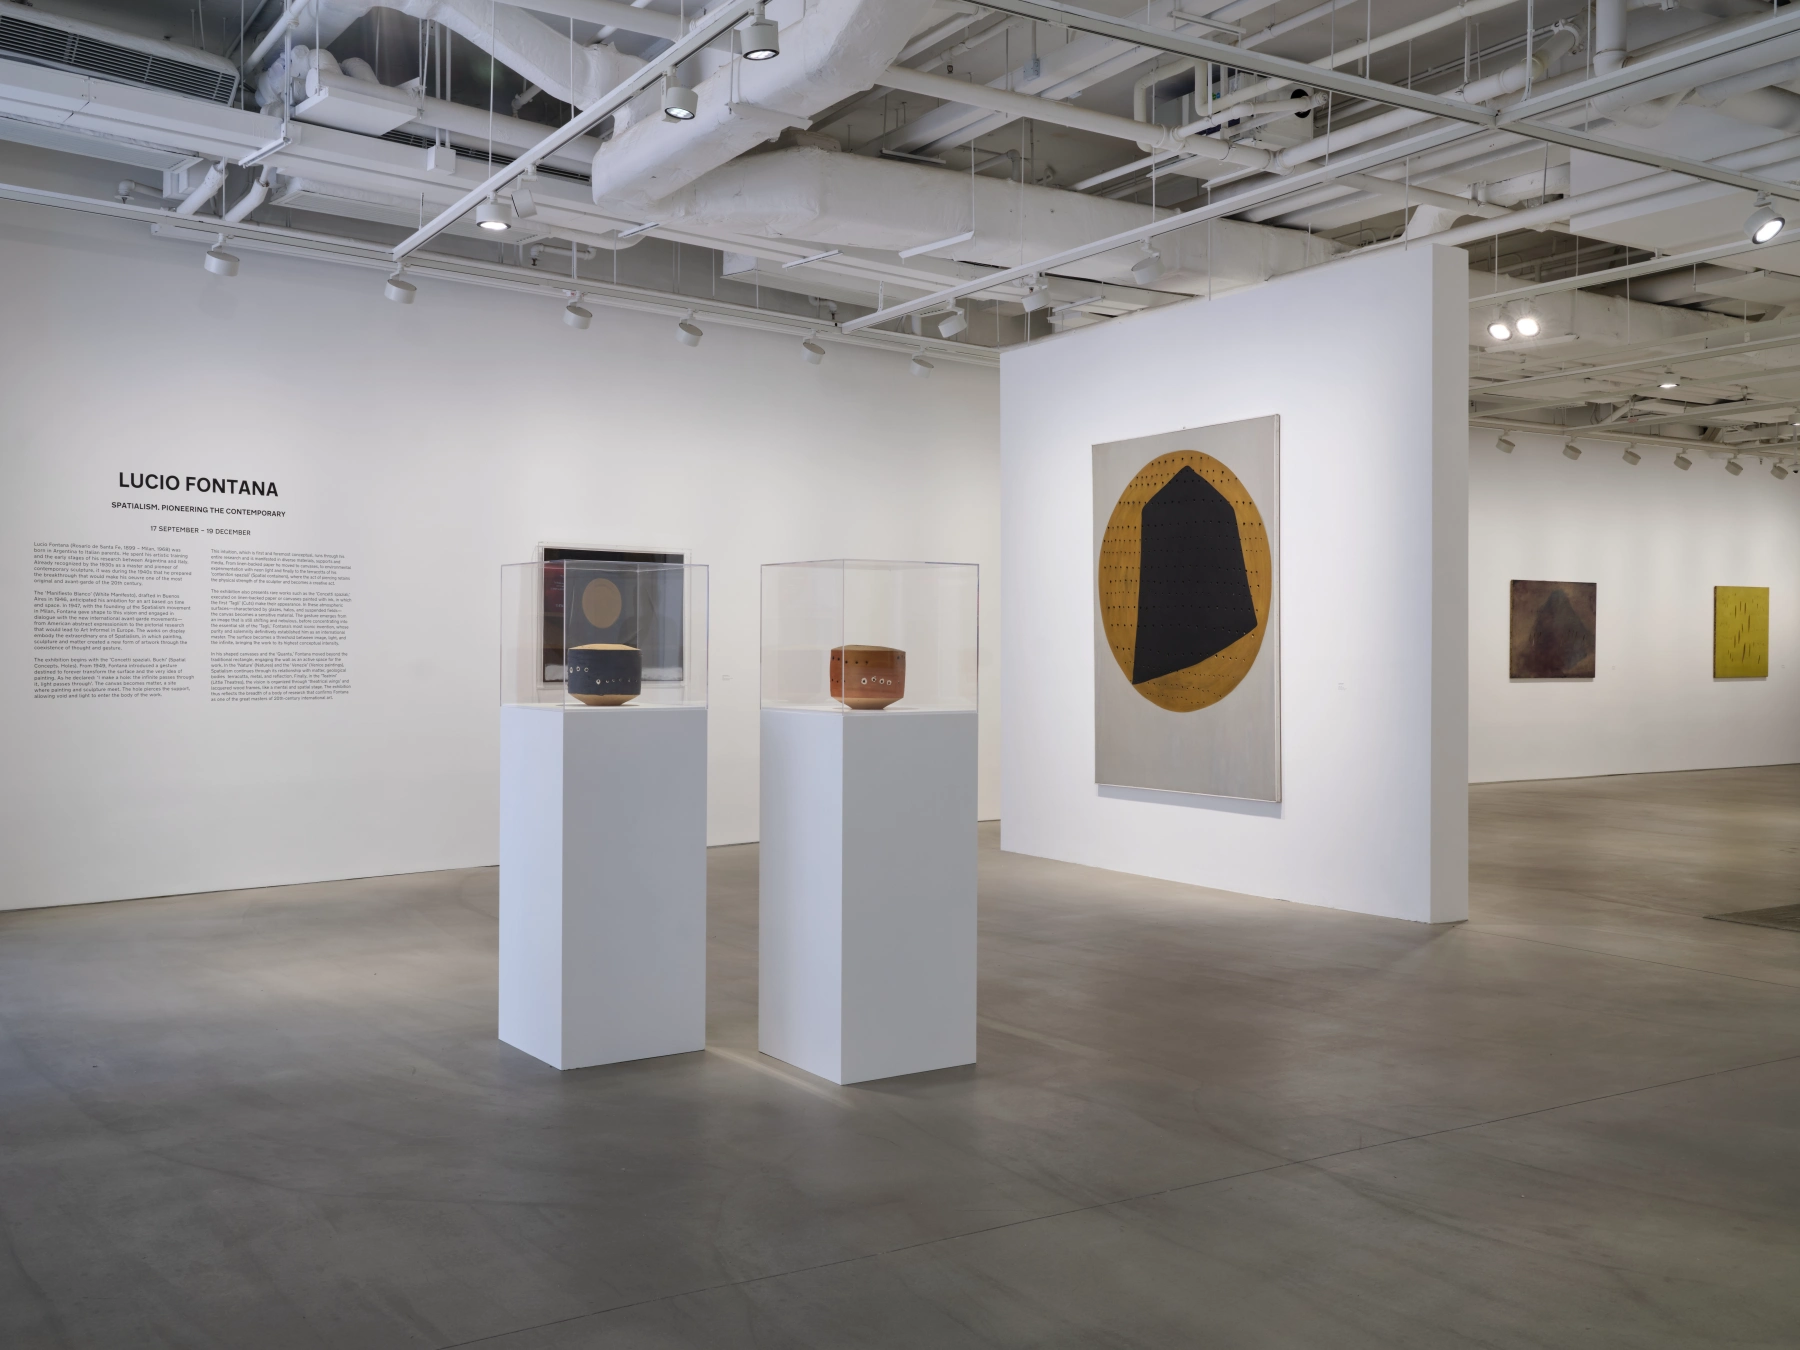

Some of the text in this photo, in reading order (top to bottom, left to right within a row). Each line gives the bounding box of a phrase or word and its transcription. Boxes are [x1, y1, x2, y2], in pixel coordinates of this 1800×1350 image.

[118, 471, 279, 497] LUCIO FONTANA
[161, 504, 209, 514] PIONEERING
[210, 507, 225, 515] THE
[225, 508, 286, 518] CONTEMPORARY
[158, 526, 199, 534] SEPTEMBER
[215, 528, 251, 536] DECEMBER
